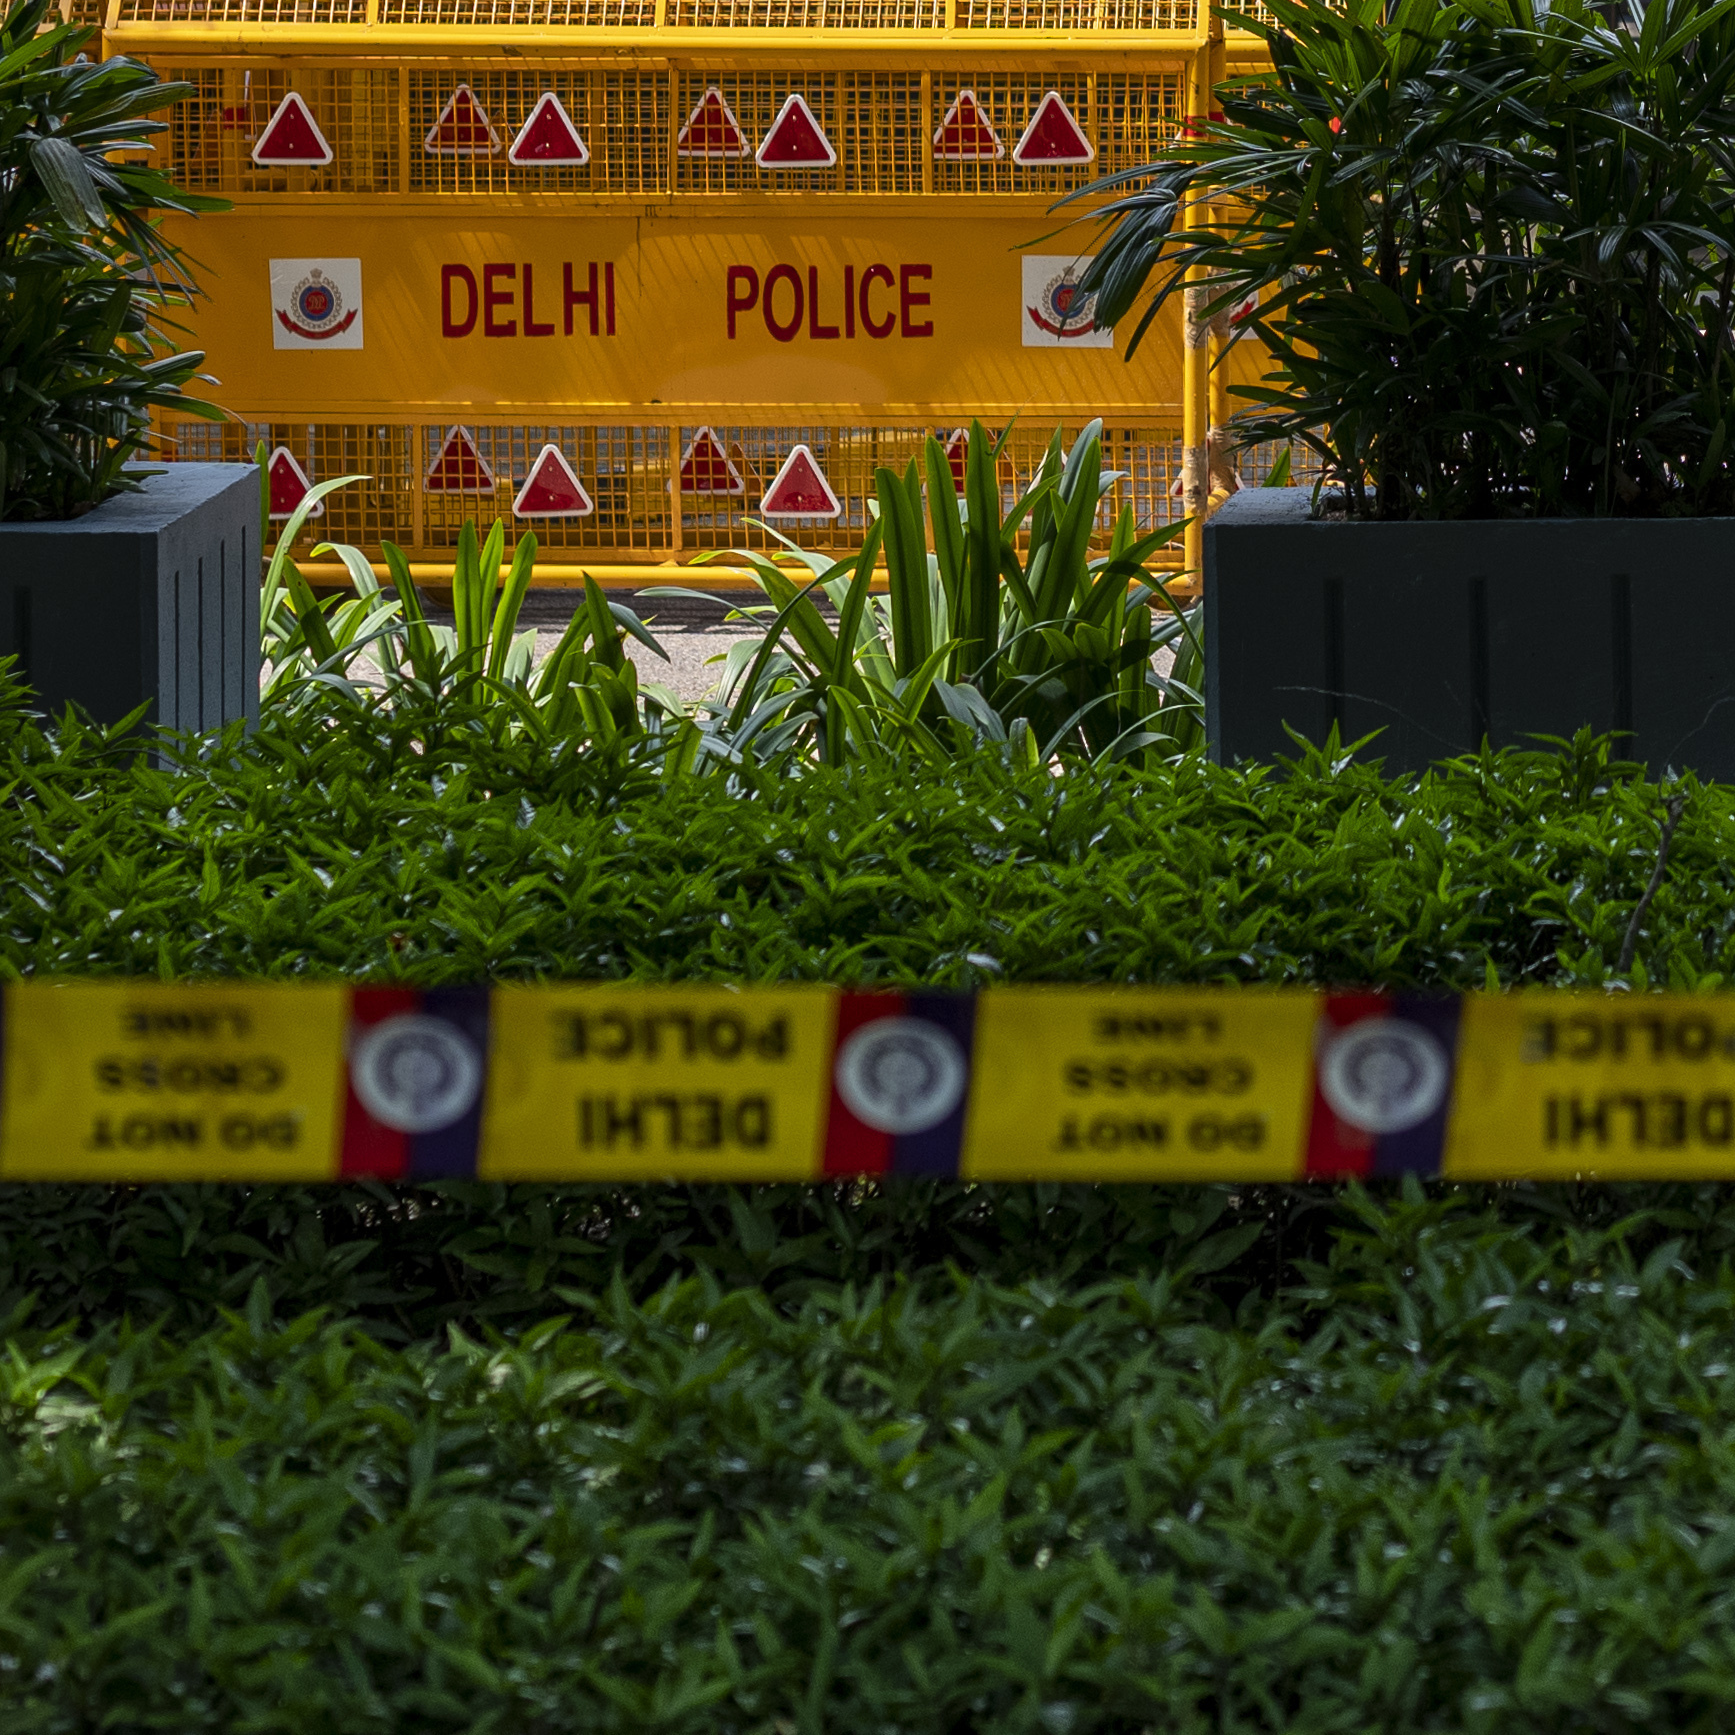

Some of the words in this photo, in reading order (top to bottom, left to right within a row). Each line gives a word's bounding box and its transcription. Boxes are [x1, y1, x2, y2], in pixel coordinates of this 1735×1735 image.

[441, 262, 616, 339] DELHI
[726, 262, 934, 343] POLICE
[550, 1006, 793, 1063] POLICE
[88, 1113, 200, 1153] NOT
[218, 1112, 301, 1153] DO
[577, 1091, 774, 1153] DELHI
[1054, 1113, 1170, 1154] NOT
[1187, 1113, 1268, 1153] DO
